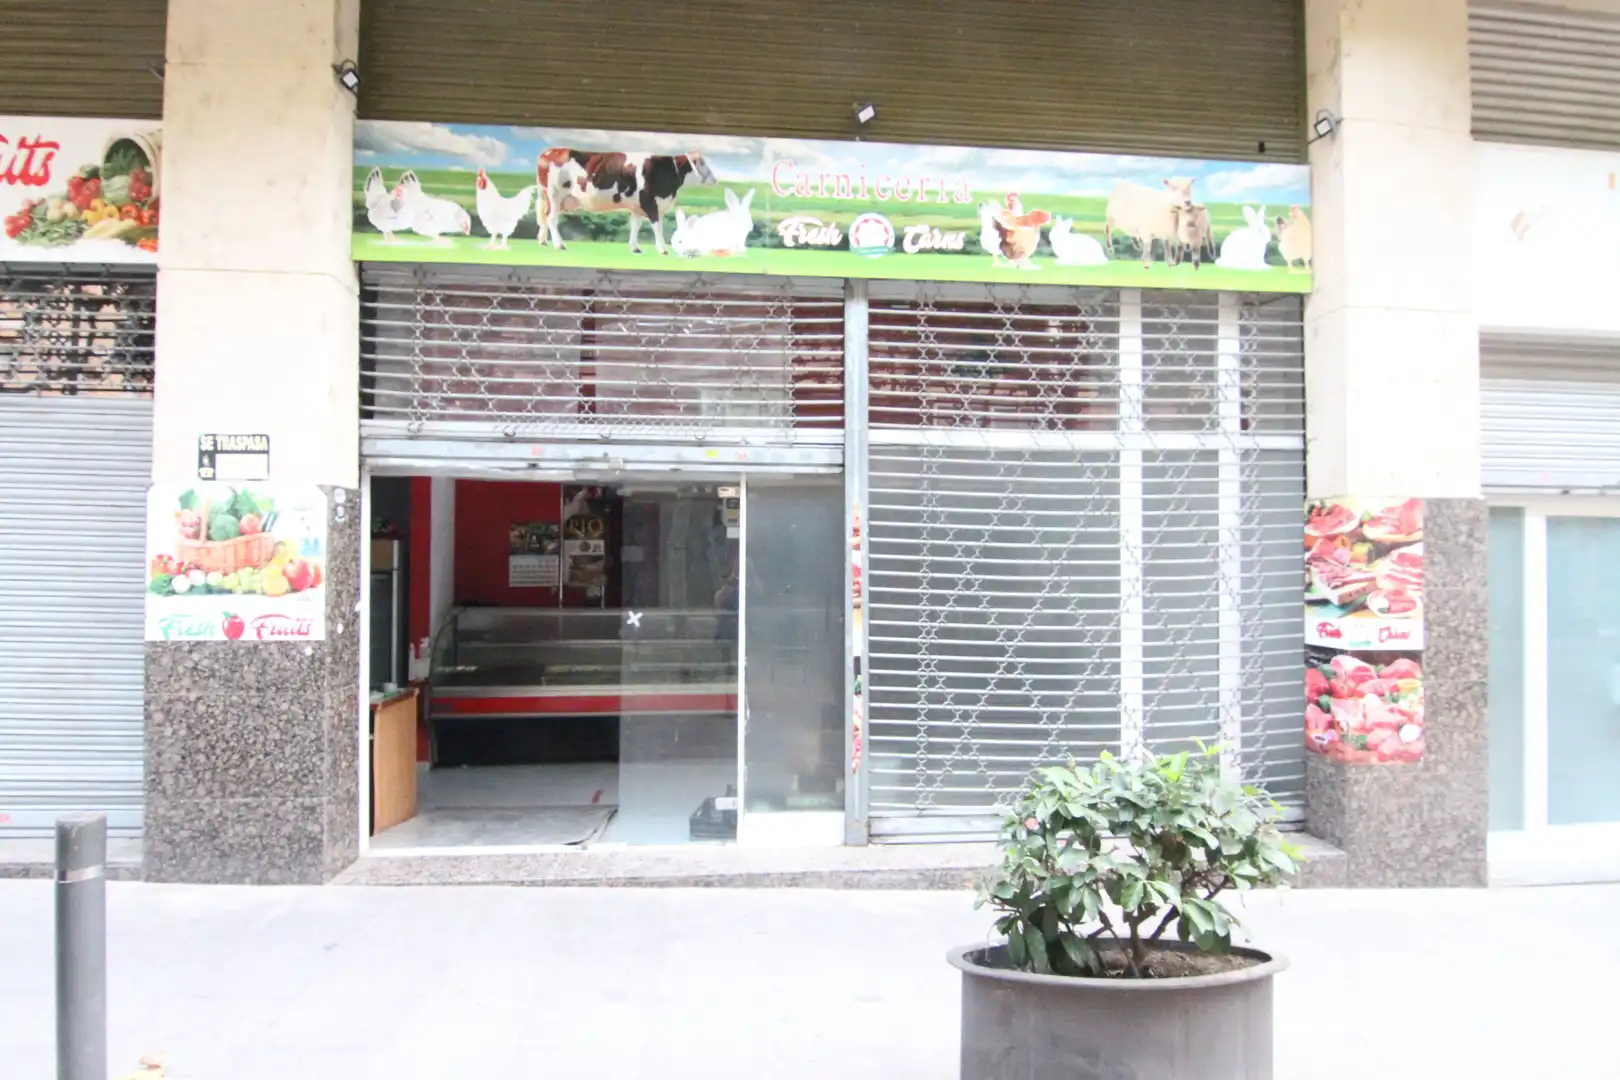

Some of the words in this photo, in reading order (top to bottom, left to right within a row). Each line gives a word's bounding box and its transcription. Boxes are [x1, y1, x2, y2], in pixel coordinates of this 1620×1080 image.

[777, 216, 843, 248] Fresh
[201, 435, 215, 451] SE
[215, 435, 269, 451] TRASPASA
[158, 614, 215, 641] Fresh
